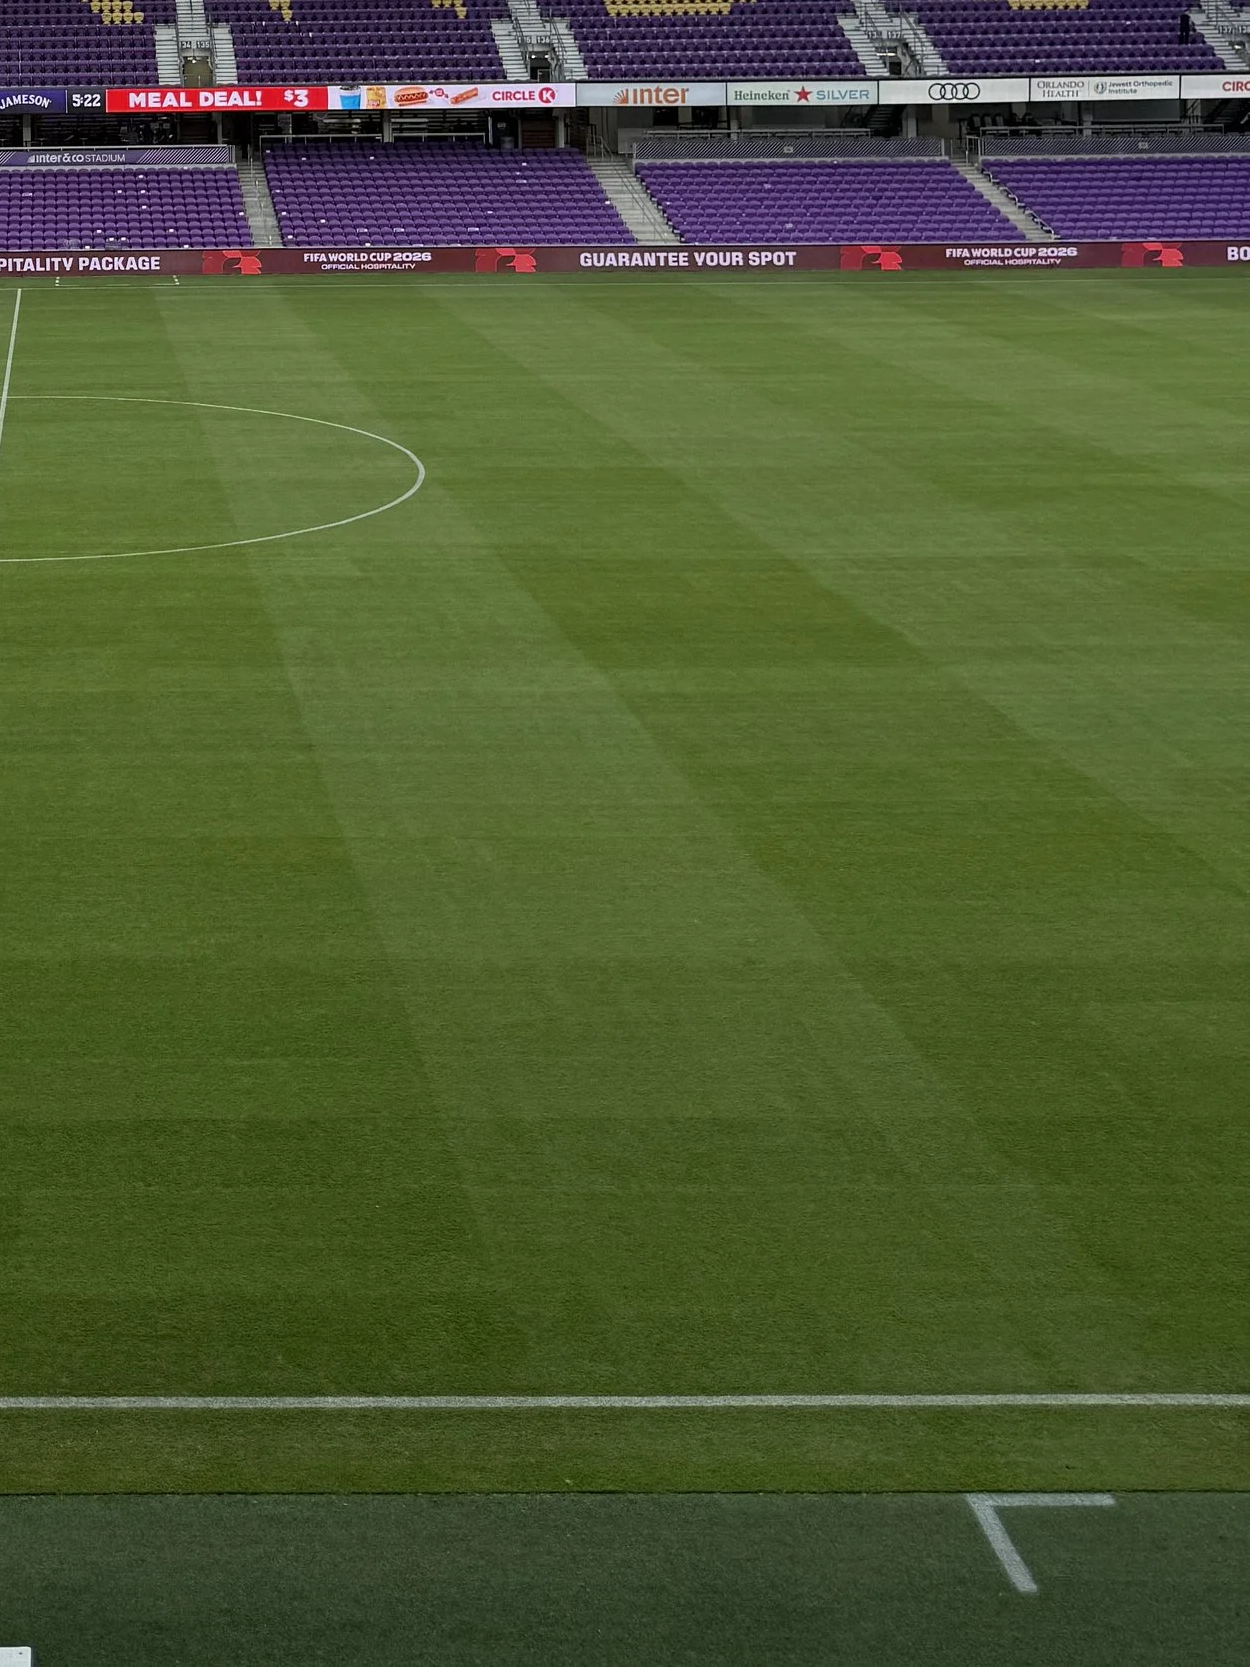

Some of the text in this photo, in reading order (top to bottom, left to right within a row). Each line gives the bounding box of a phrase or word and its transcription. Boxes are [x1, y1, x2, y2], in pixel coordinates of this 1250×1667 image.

[1036, 80, 1085, 89] ORLANDO
[1133, 80, 1173, 88] Orthopedic
[129, 89, 309, 108] MEAL DEAL! $3
[492, 88, 554, 102] CIRCLE K
[632, 87, 689, 104] inter
[733, 89, 870, 101] Heineken SILVER
[1042, 90, 1079, 98] HEALTH
[0, 94, 50, 110] JAMESON
[72, 93, 101, 108] 5:22
[35, 154, 126, 164] inter&co STADIUM
[303, 252, 432, 263] FIFA WORLD CUP 2026
[945, 247, 1078, 258] FIFA WORLD CUP 2026
[79, 256, 161, 272] PACKAGE
[579, 251, 797, 267] GUARANTEE YOUR SPOT
[963, 258, 1062, 266] OFFICIAL HOSPITALITY
